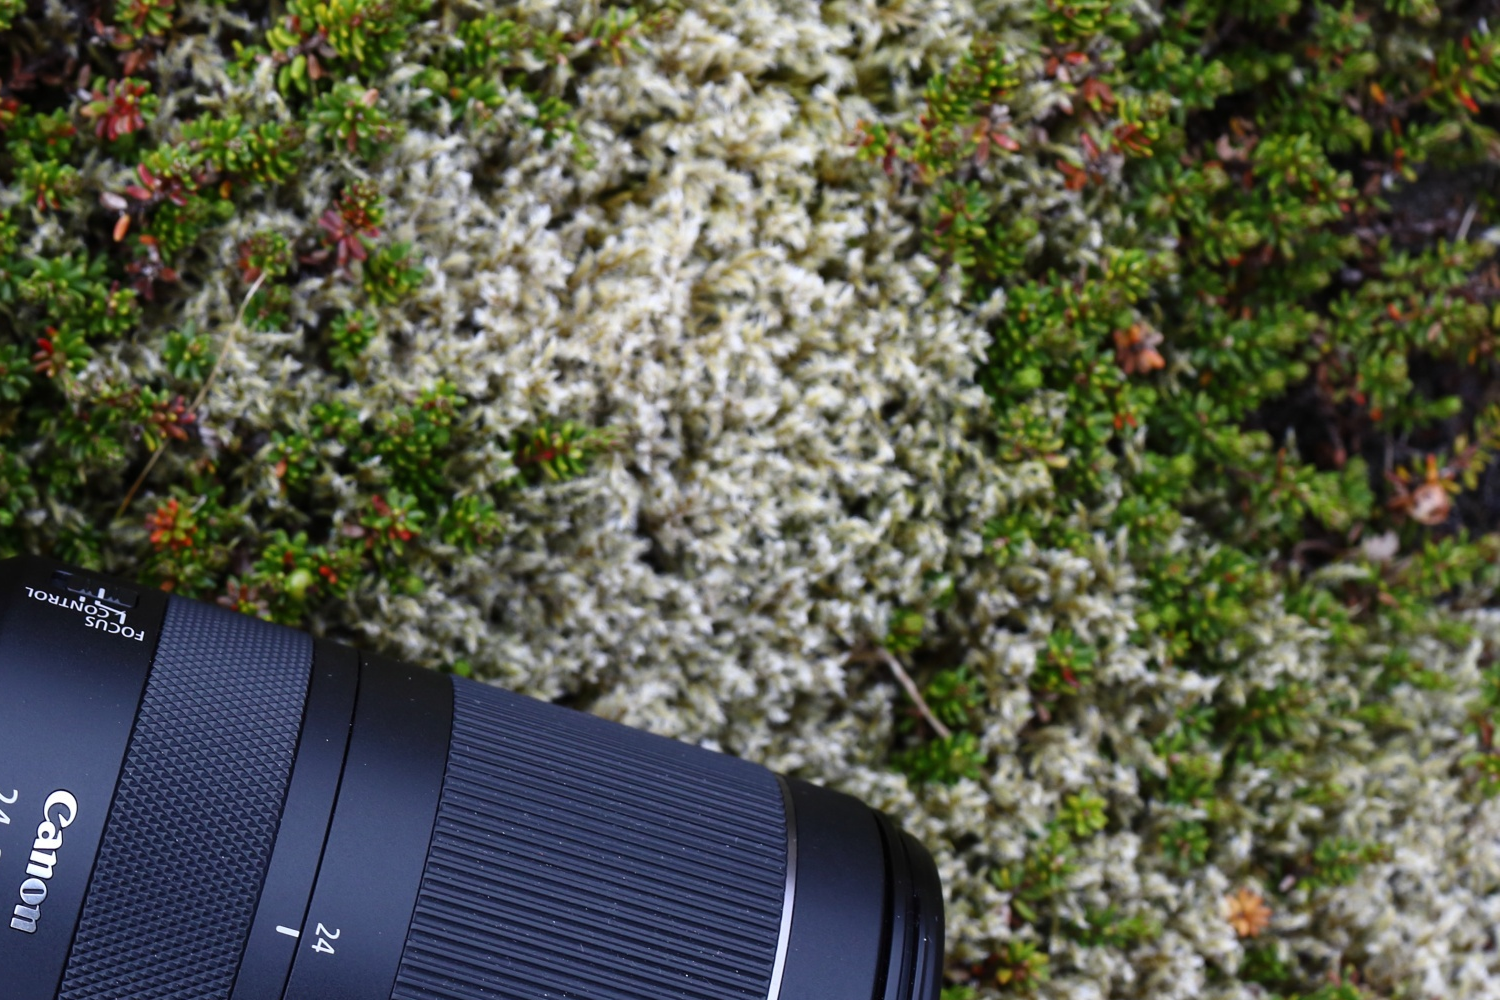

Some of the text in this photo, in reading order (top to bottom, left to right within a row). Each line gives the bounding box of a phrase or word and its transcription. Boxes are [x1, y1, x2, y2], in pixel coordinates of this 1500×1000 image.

[25, 586, 110, 619] CONTROL
[84, 616, 145, 642] FOCUS
[9, 788, 78, 934] Canon
[311, 922, 340, 955] 24
